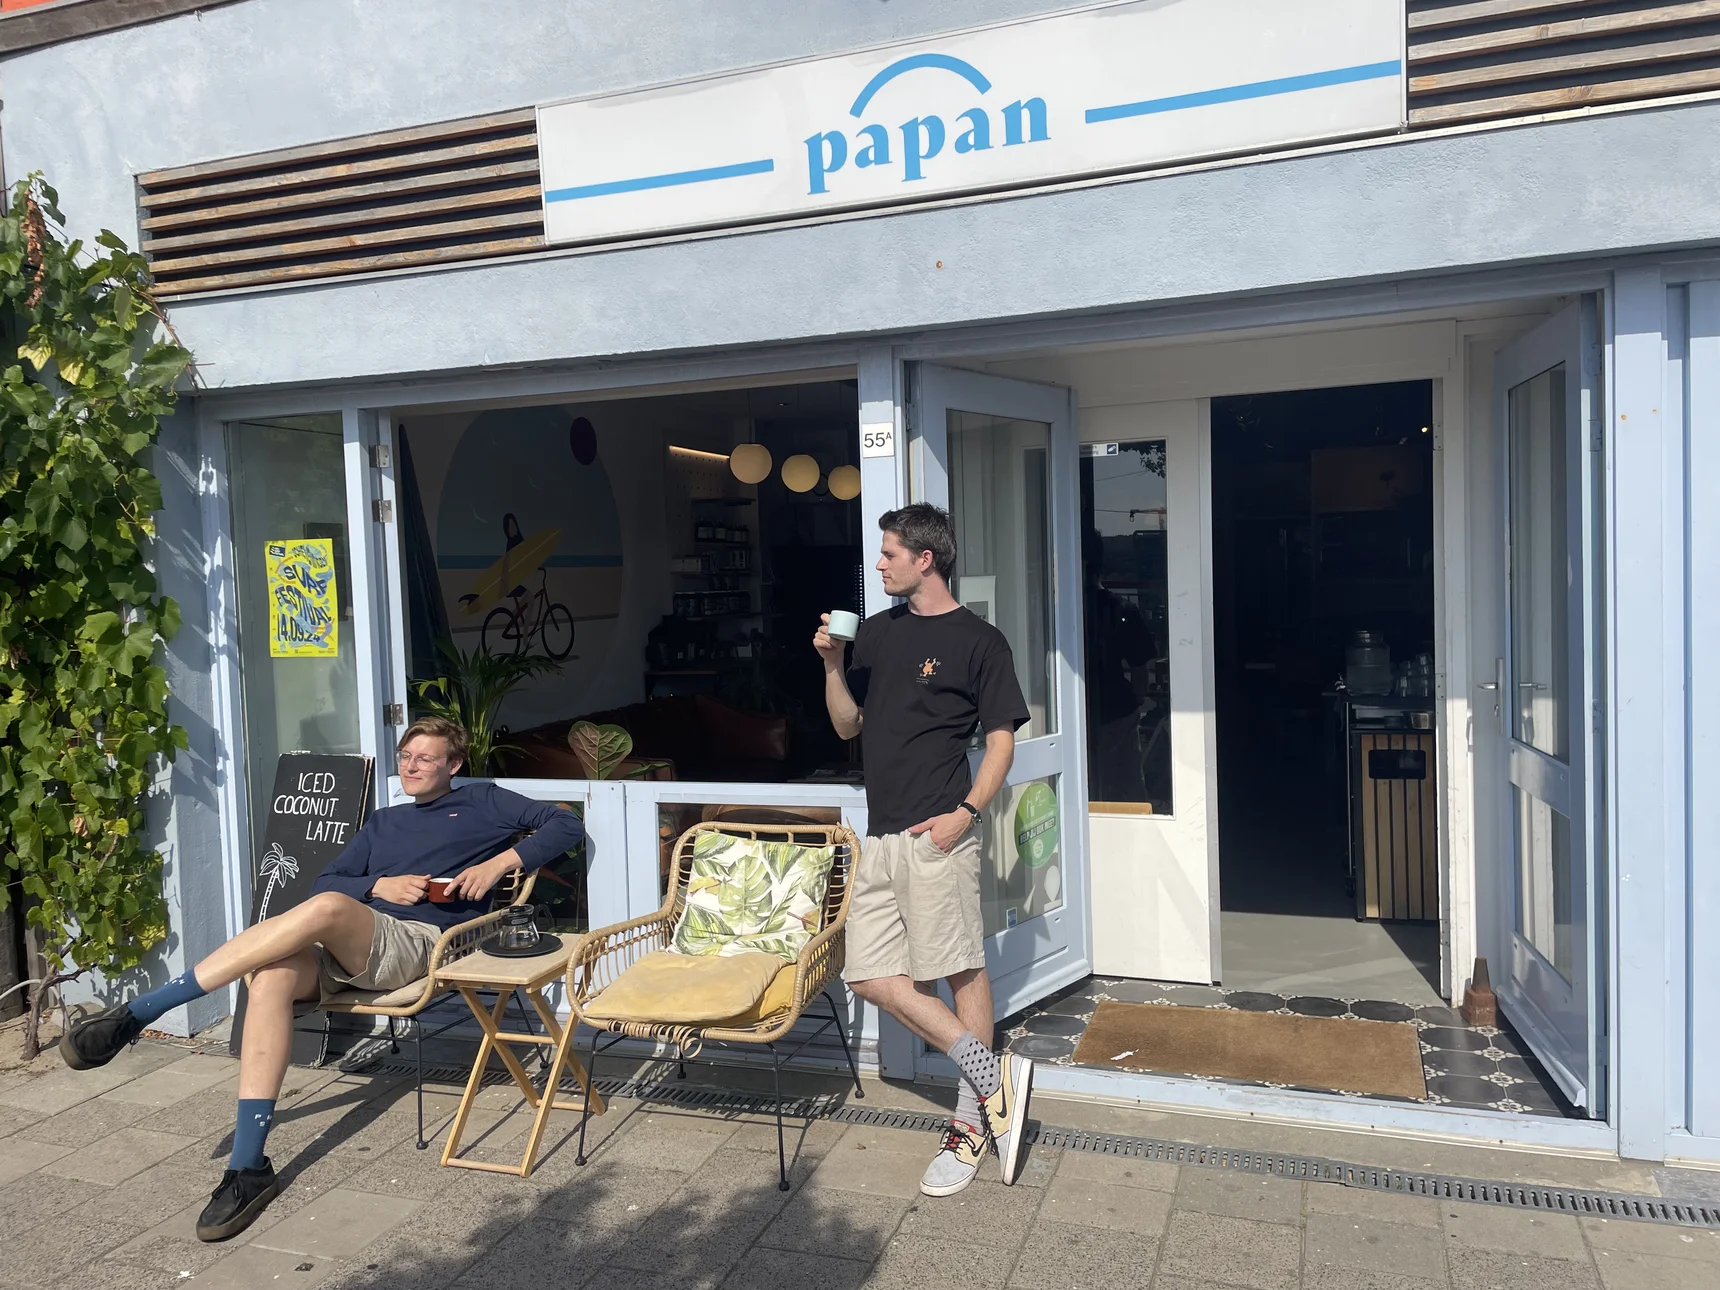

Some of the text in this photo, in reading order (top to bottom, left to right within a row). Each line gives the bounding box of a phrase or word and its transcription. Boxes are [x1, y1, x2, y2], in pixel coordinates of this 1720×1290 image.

[803, 97, 1052, 195] papan
[864, 432, 892, 448] 55A
[275, 585, 332, 626] FESTIVAL
[298, 772, 336, 794] ICED
[273, 795, 339, 818] COCONUT
[305, 820, 350, 844] LATTE
